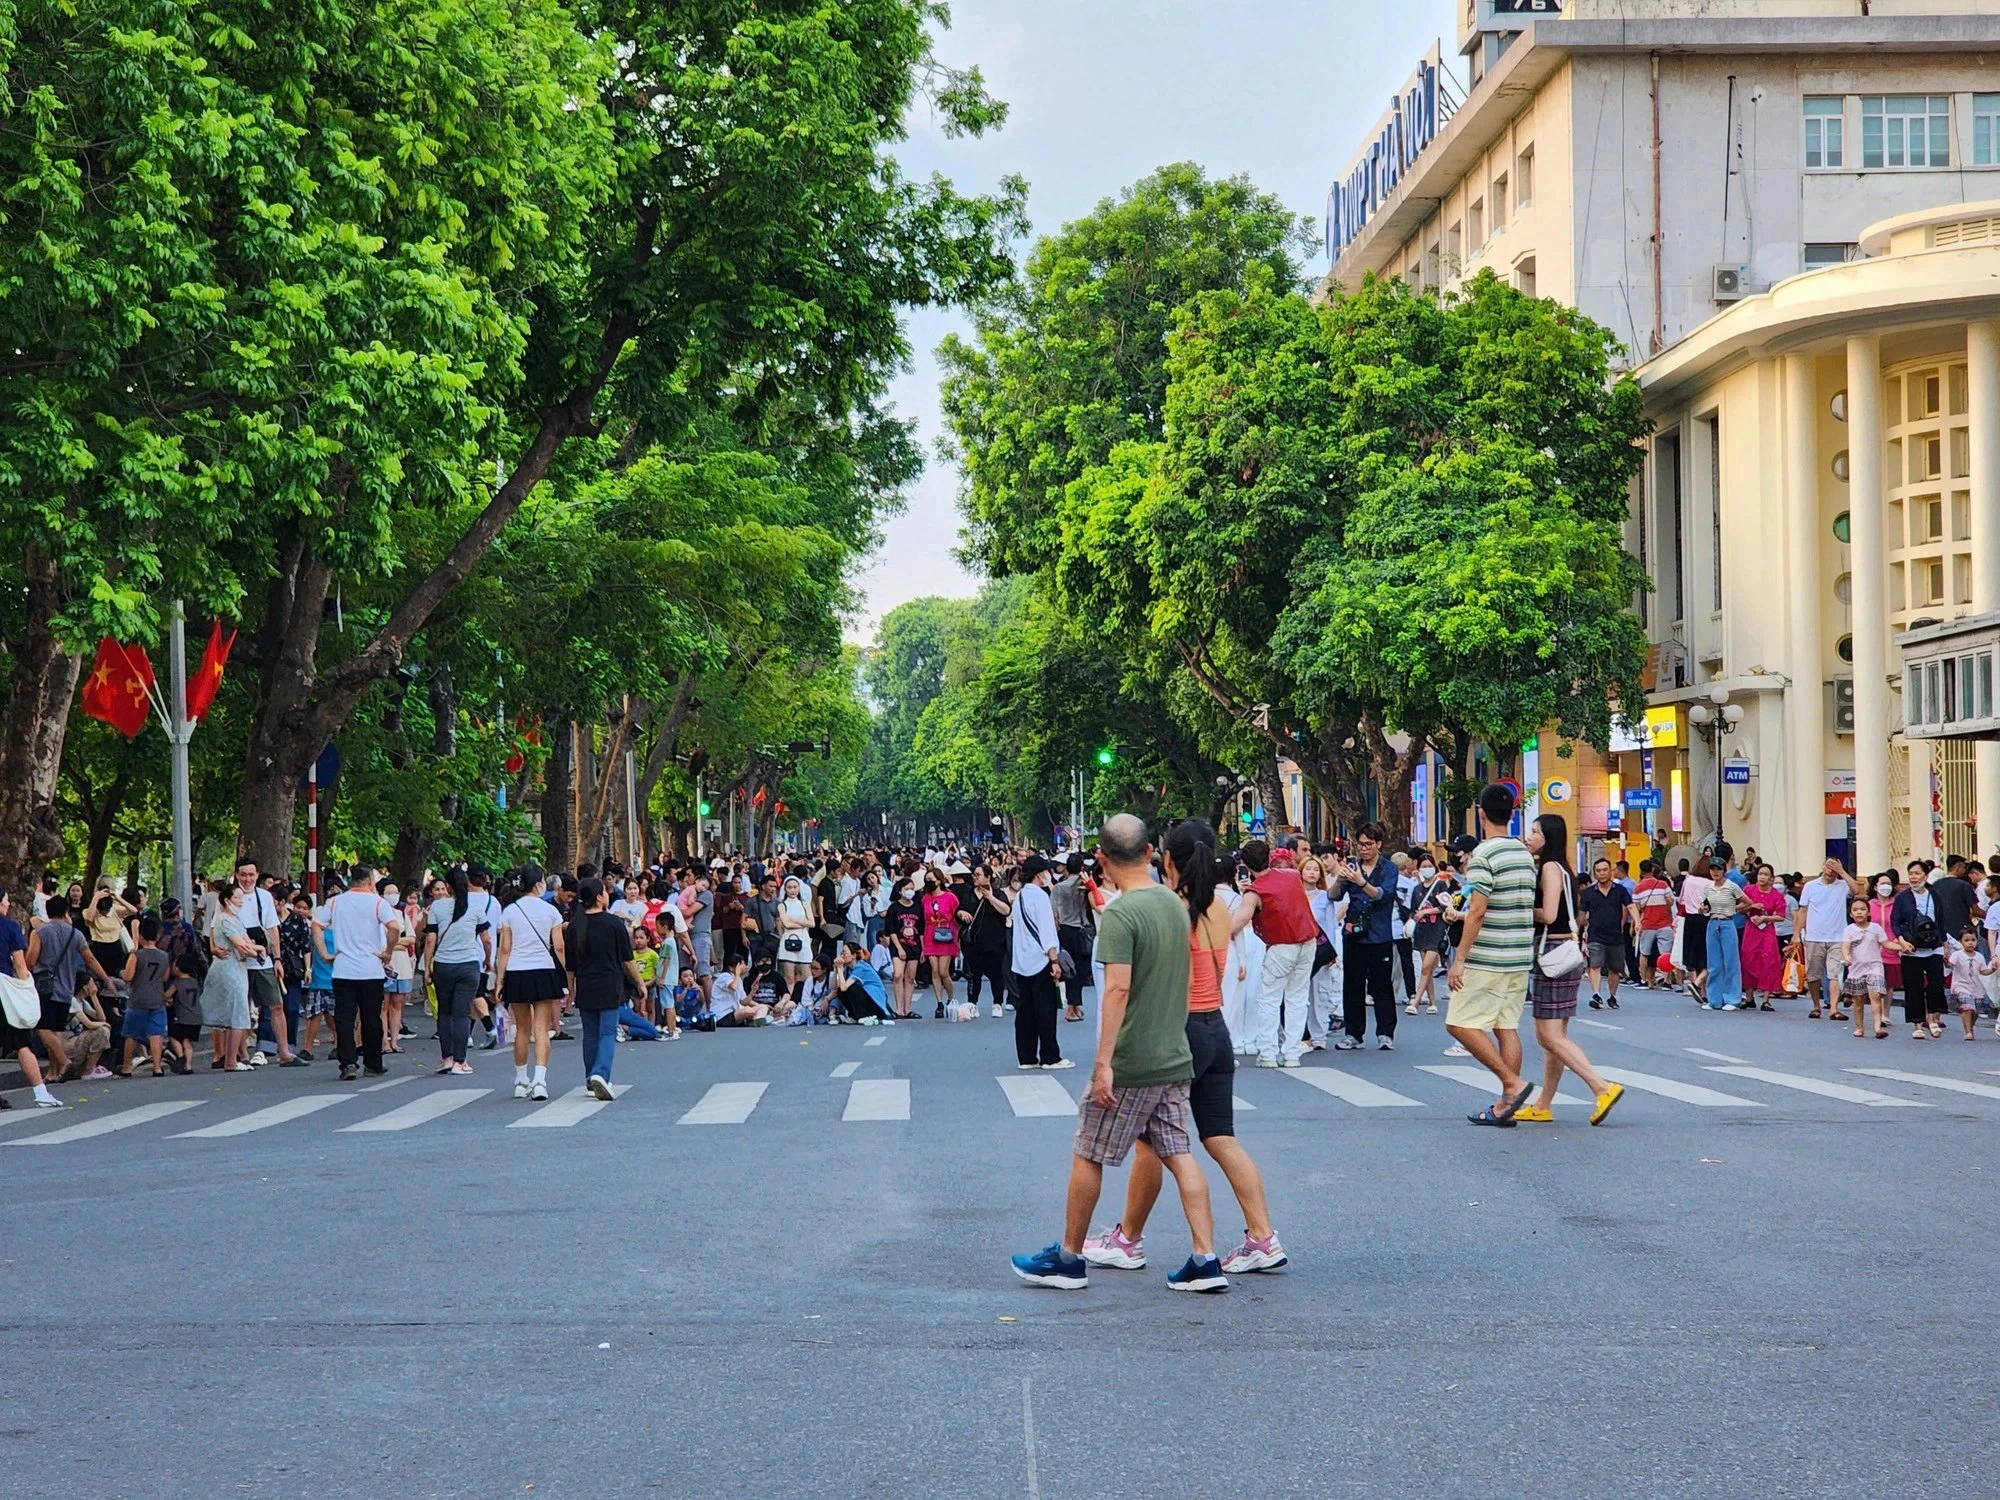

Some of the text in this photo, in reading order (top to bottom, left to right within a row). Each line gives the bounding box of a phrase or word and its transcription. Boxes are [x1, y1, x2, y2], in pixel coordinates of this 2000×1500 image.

[1340, 142, 1380, 248] VNPT
[1379, 95, 1404, 200] HÀ
[1726, 771, 1748, 781] ATM
[1842, 797, 1856, 809] AT
[148, 962, 160, 981] 7
[186, 988, 197, 1007] 7
